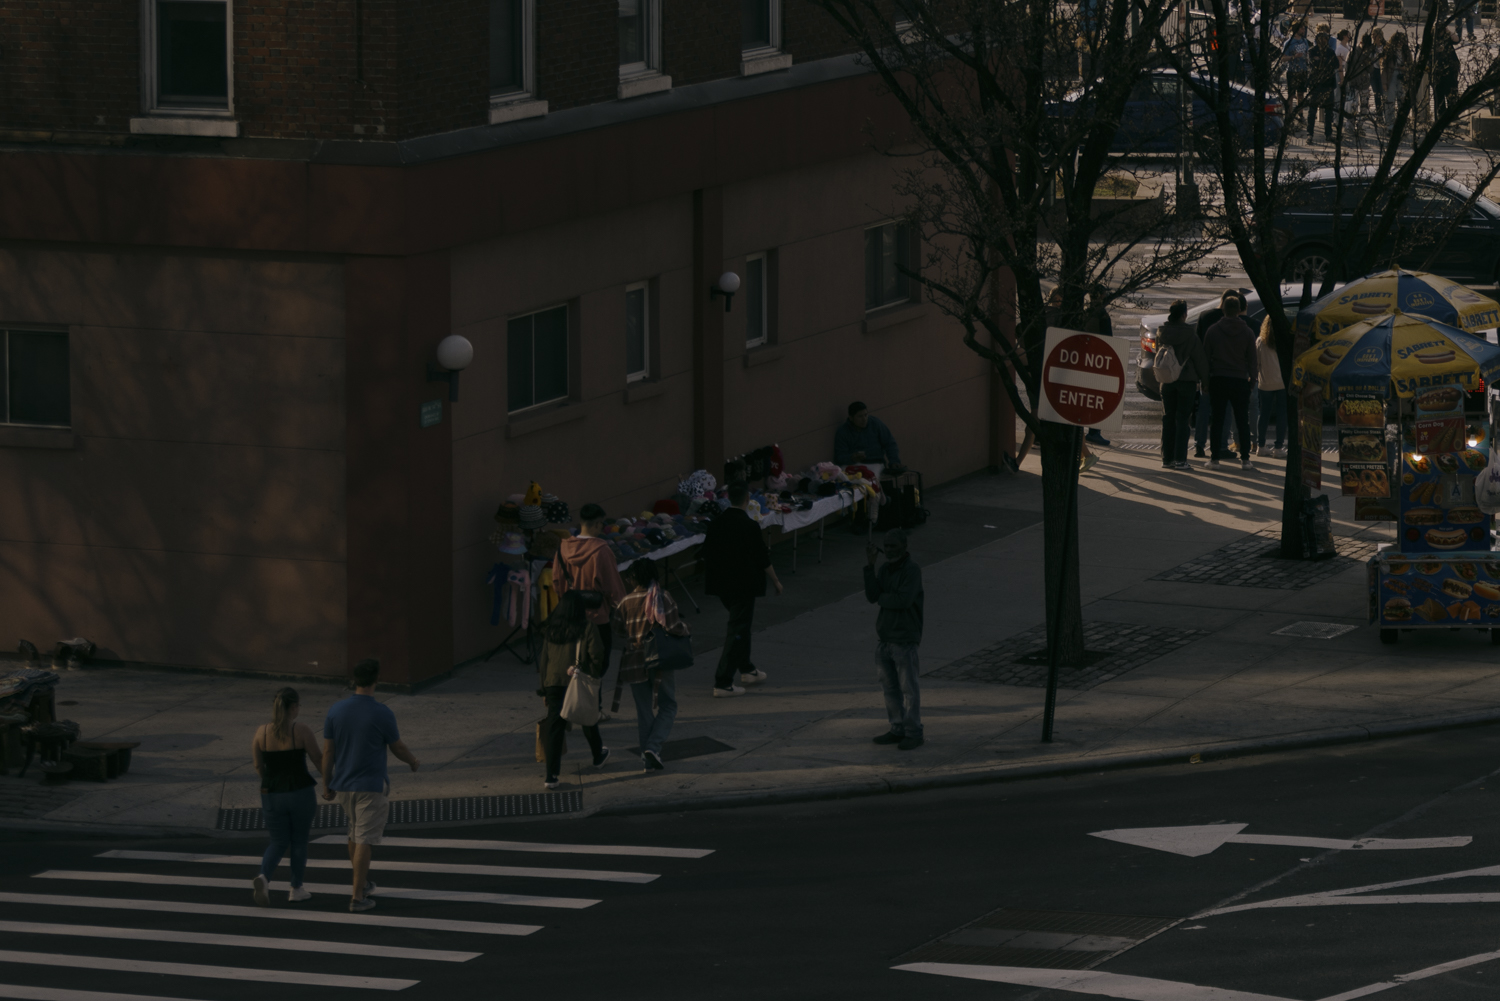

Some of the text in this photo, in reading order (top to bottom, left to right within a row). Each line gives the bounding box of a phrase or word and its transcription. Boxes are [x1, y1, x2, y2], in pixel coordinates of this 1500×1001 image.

[1338, 291, 1394, 305] SABRETT
[1461, 309, 1500, 329] SABRETT
[1059, 348, 1113, 371] DO NOT
[1397, 340, 1446, 360] SABRETT
[1396, 371, 1476, 394] SABRETT
[1058, 389, 1105, 411] ENTER
[1451, 484, 1461, 497] A
